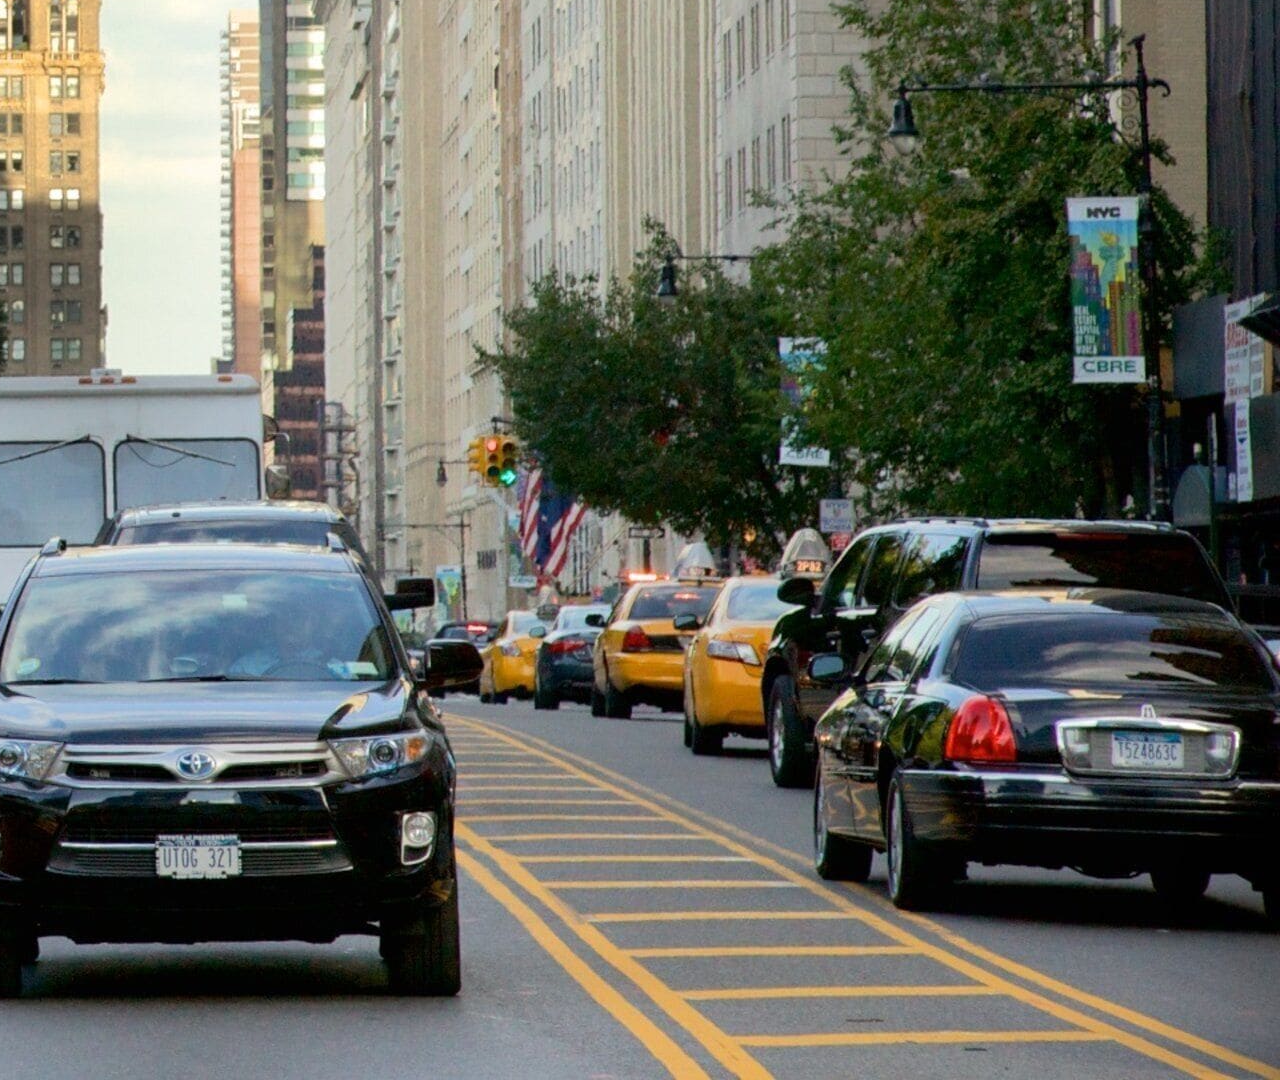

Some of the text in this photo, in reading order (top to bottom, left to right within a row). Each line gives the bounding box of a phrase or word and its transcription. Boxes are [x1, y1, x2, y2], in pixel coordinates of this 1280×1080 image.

[1086, 206, 1122, 219] NYC
[1082, 360, 1137, 374] CBRE
[208, 847, 232, 868] 321
